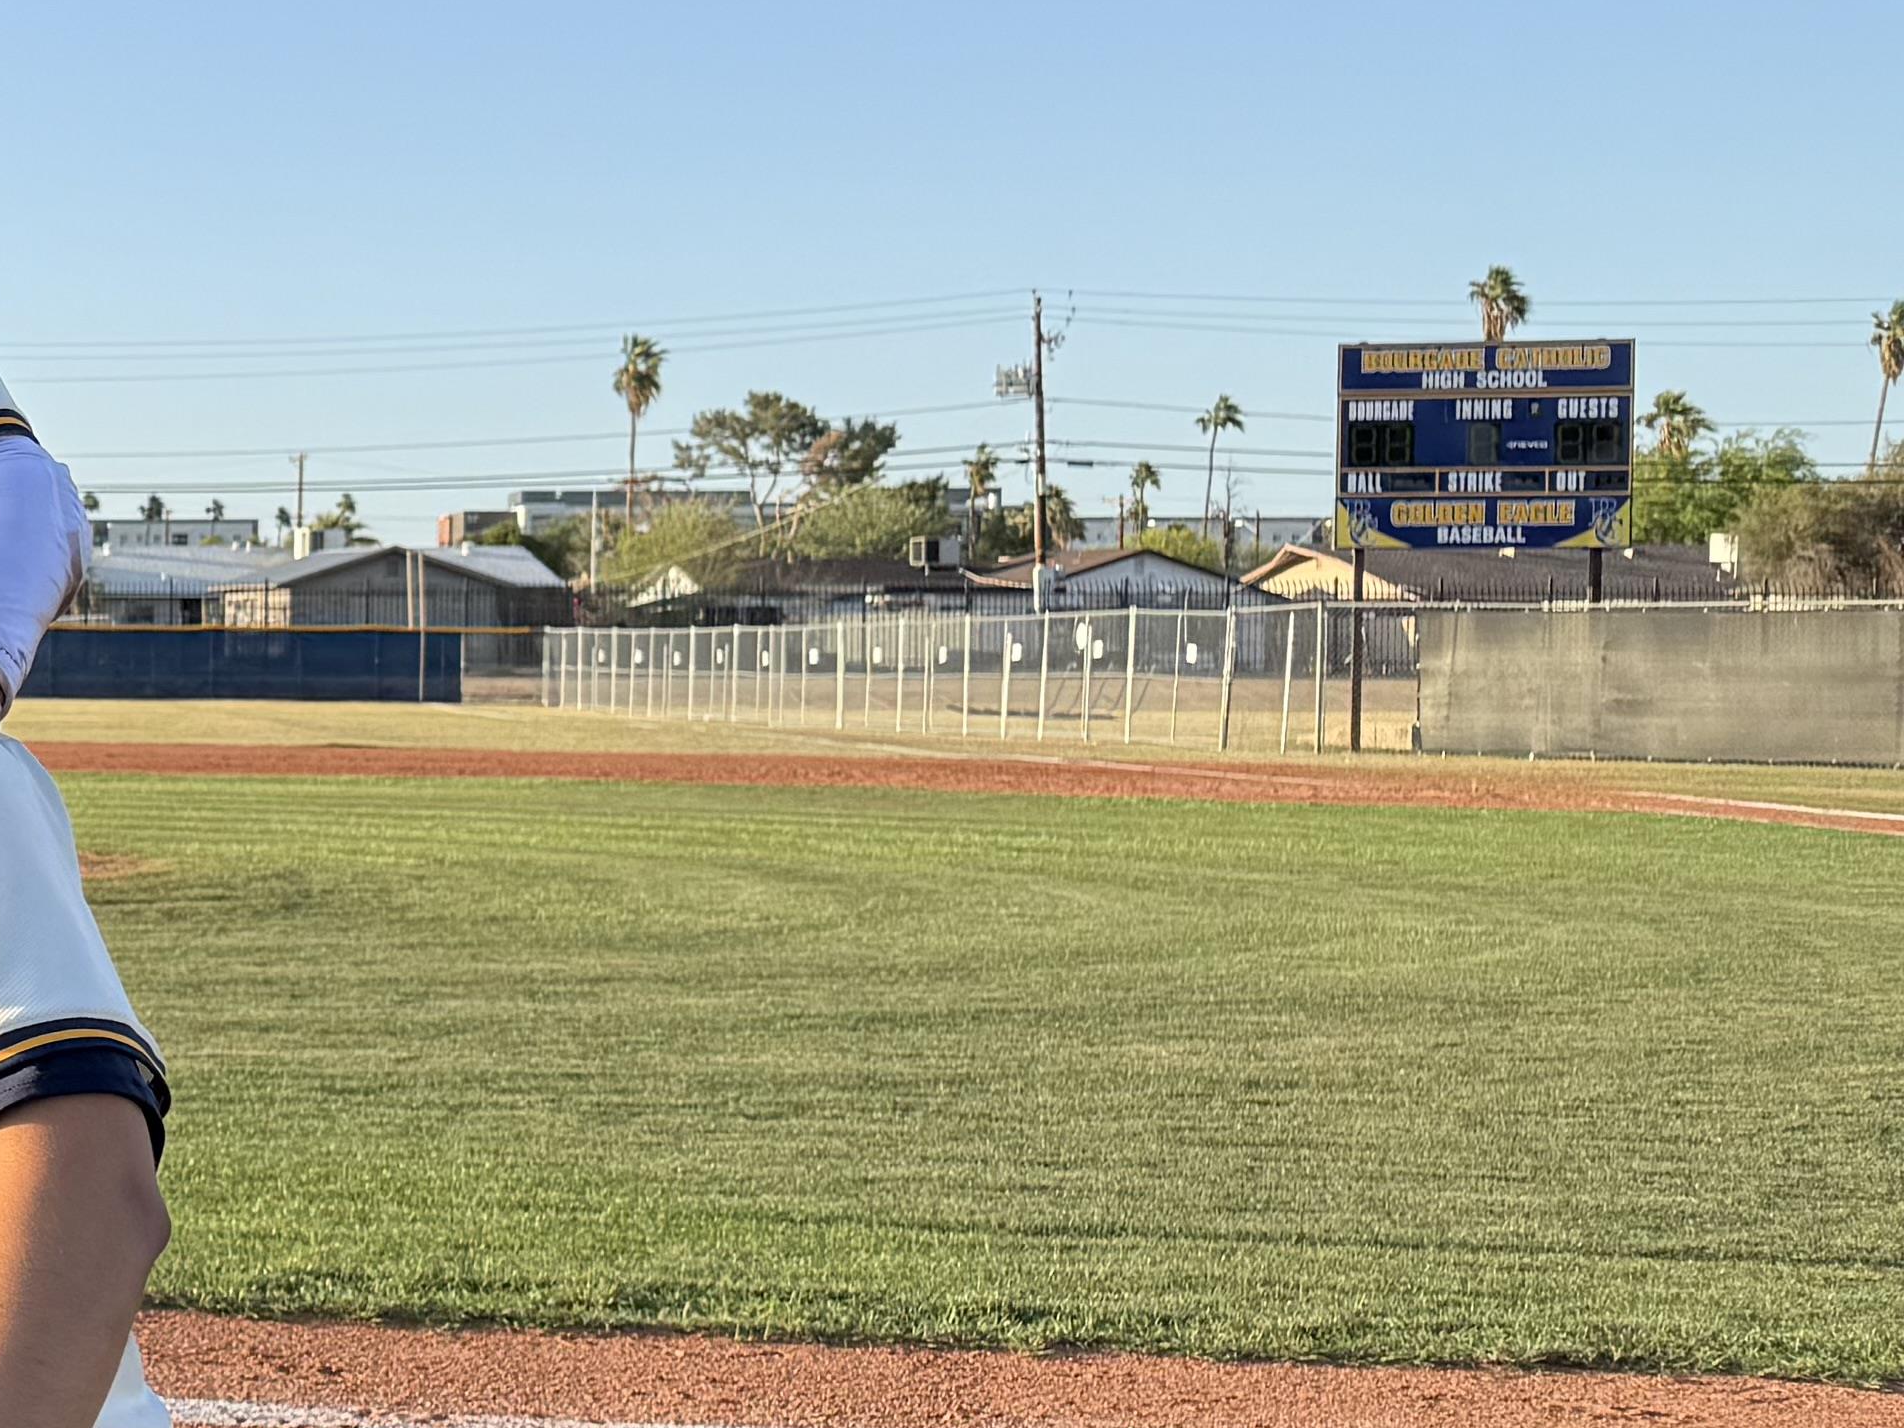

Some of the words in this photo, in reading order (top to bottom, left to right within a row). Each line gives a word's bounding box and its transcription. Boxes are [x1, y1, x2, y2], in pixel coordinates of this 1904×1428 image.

[1361, 348, 1485, 373] BOURGADE
[1496, 346, 1611, 370] CATHOLIC
[1421, 371, 1465, 389] HIGH
[1476, 370, 1547, 388] SCHOOL
[1348, 400, 1414, 421] BOURGADE
[1455, 398, 1512, 420] INNING
[1557, 397, 1619, 419] GUESTS
[1347, 471, 1382, 493] BALL
[1447, 471, 1502, 492] STRIKE
[1556, 471, 1586, 492] OUT
[1390, 500, 1486, 528] GOLDEN
[1497, 499, 1575, 526] EAGLE
[1437, 525, 1526, 544] BASEBALL
